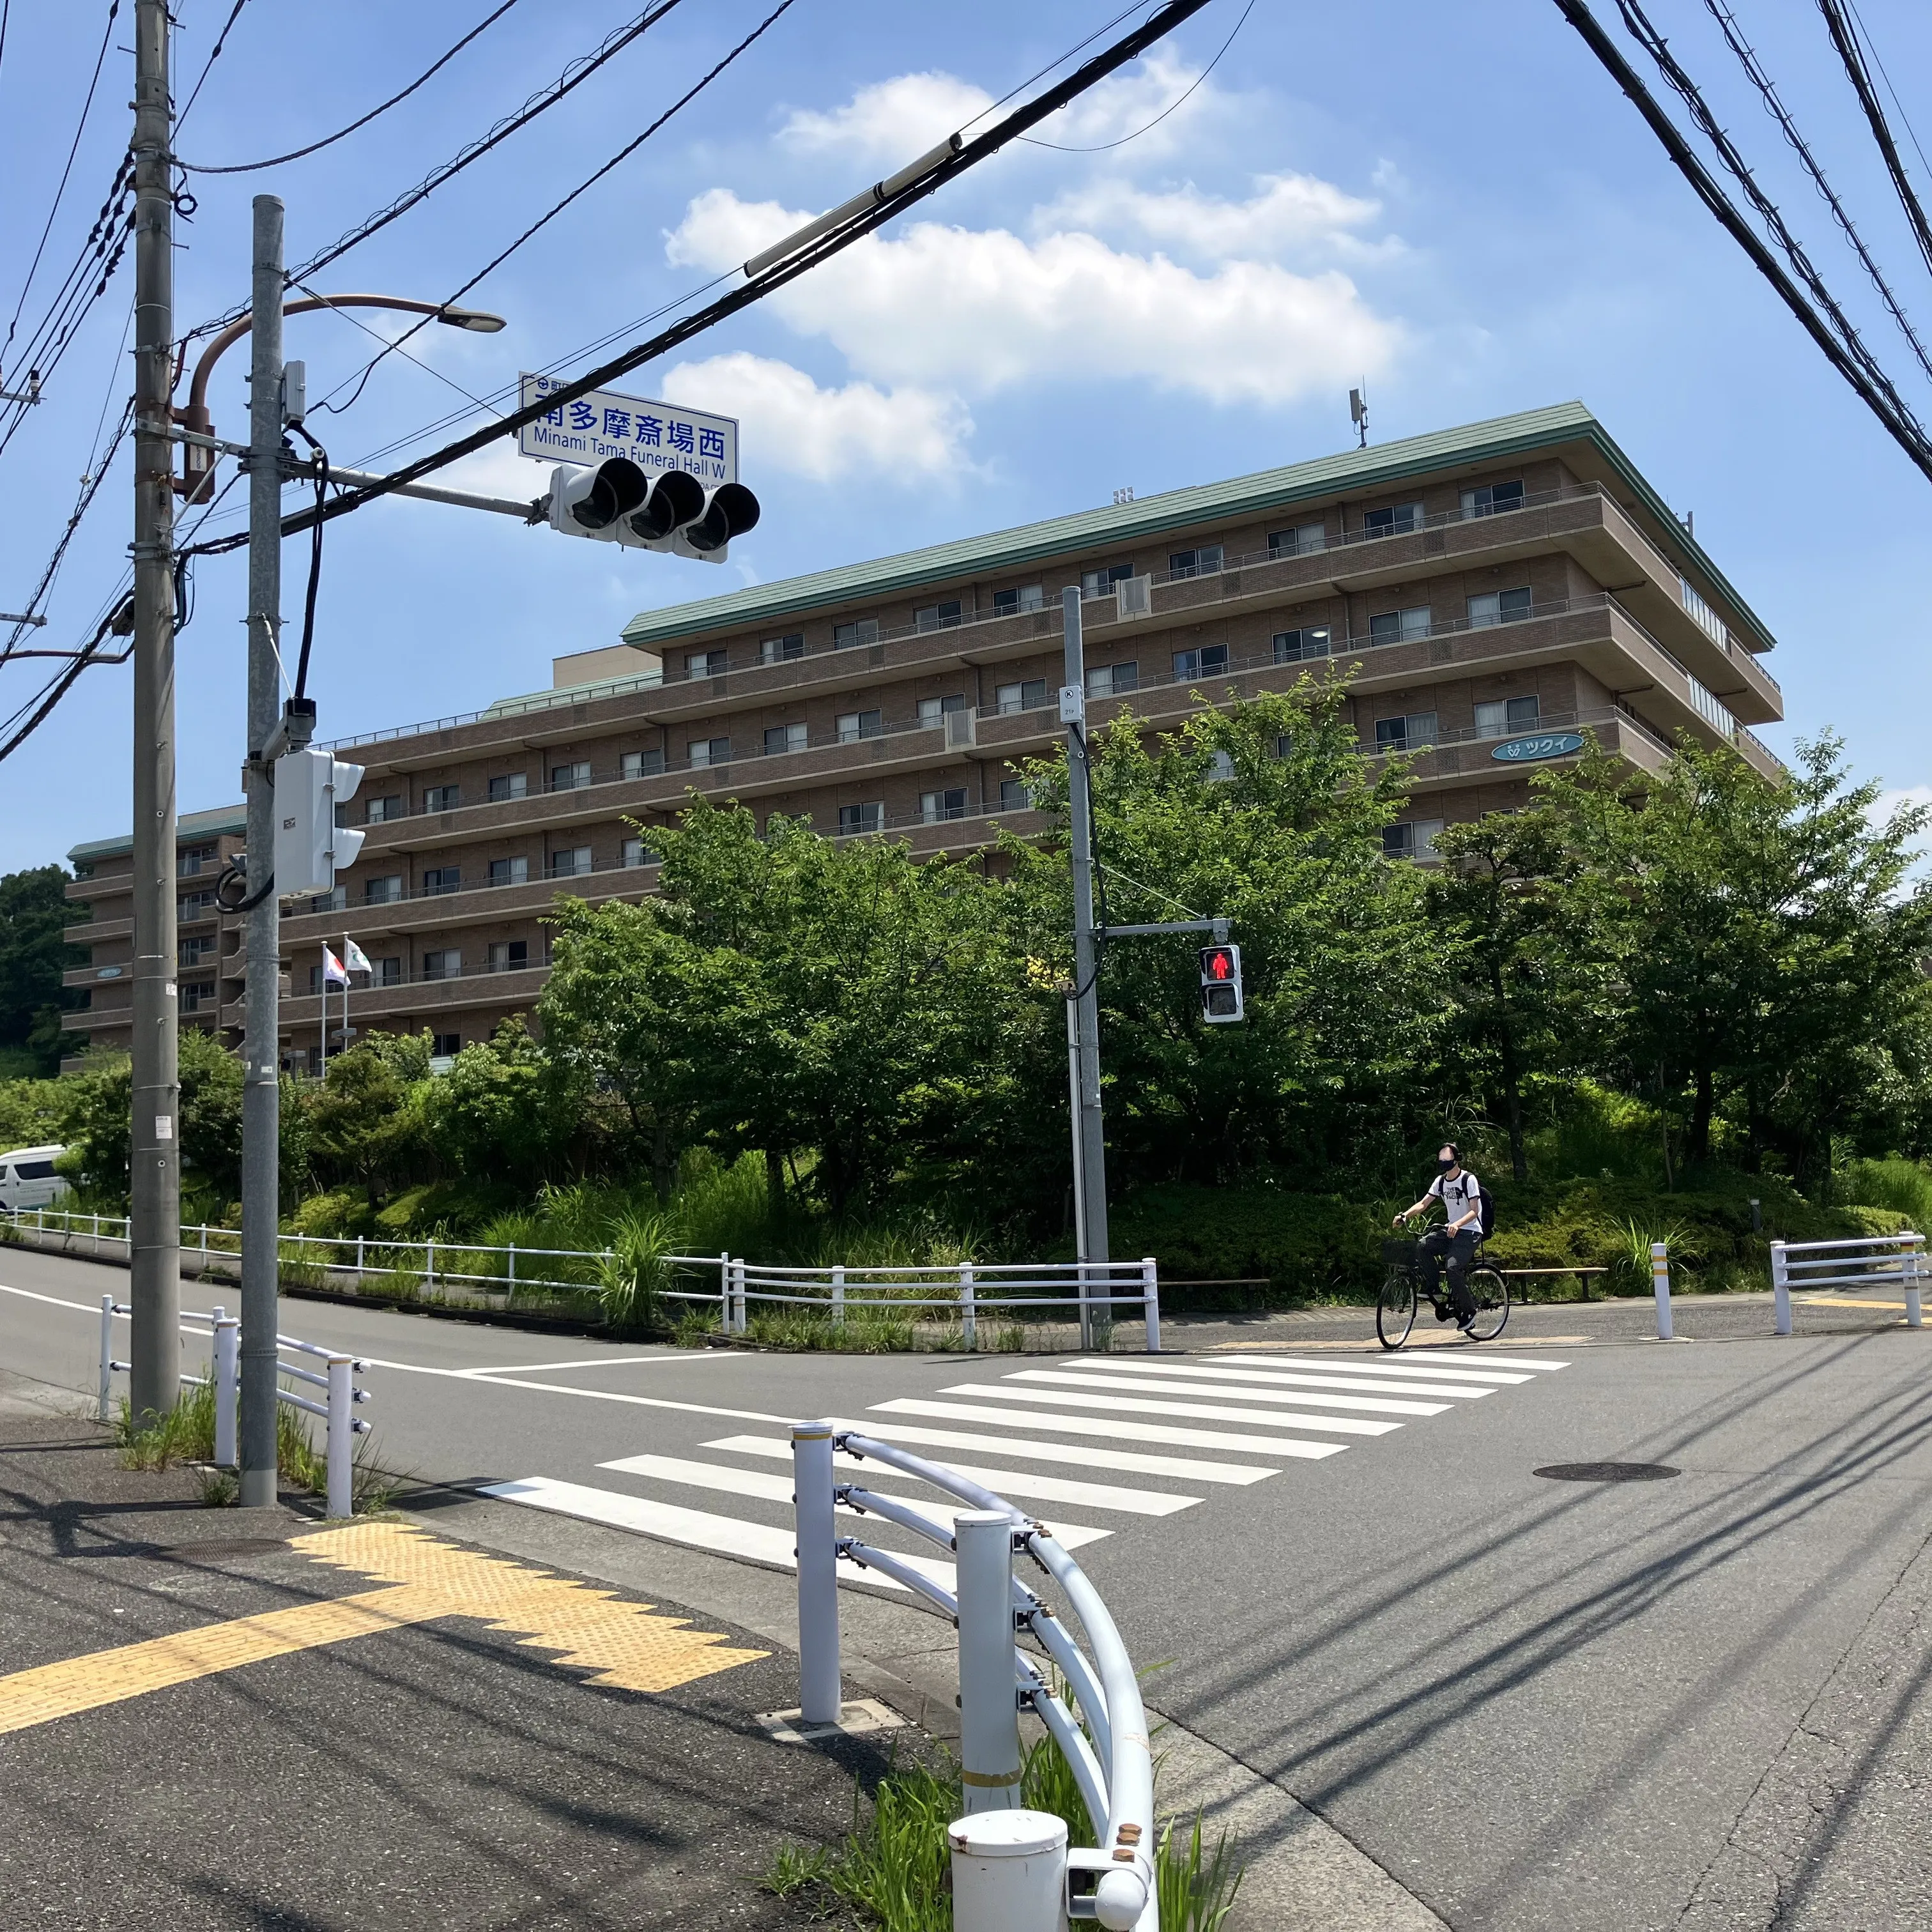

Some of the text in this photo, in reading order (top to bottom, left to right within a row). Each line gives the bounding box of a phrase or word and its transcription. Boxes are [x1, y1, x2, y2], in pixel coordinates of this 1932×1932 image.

[534, 426, 726, 479] Minami Tama Funeral Hall W
[1526, 737, 1567, 755] ツクイ
